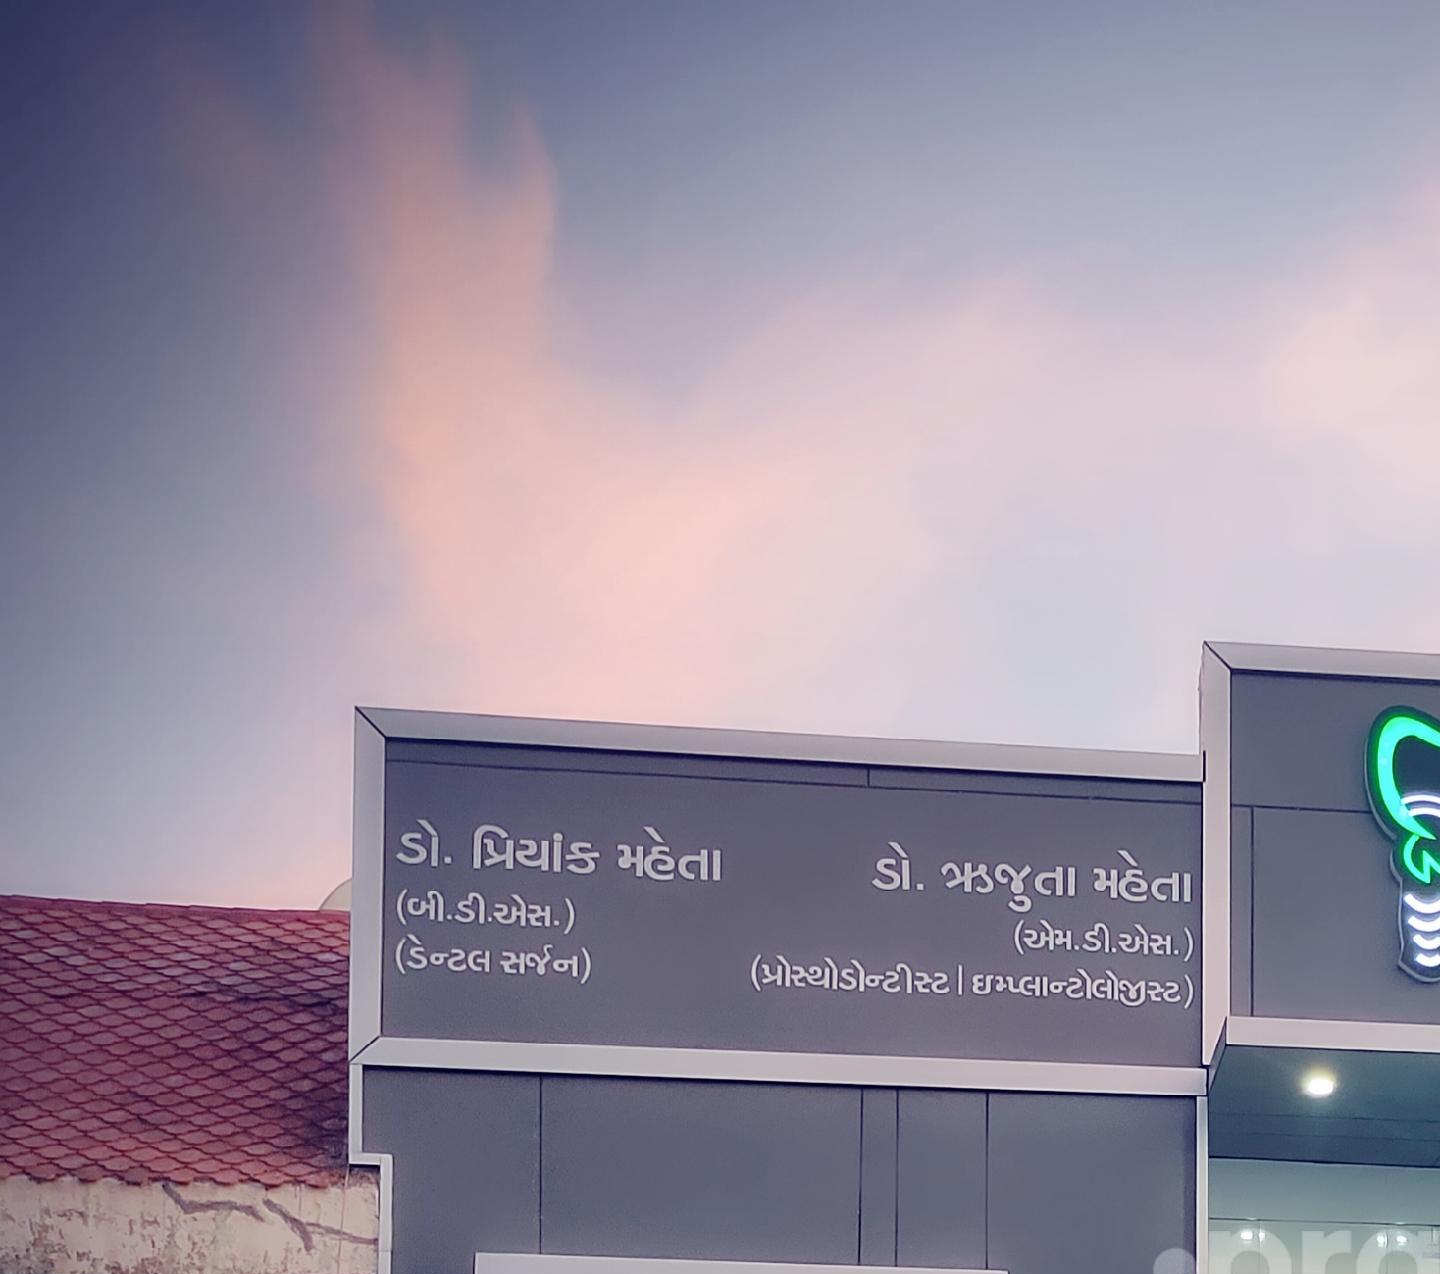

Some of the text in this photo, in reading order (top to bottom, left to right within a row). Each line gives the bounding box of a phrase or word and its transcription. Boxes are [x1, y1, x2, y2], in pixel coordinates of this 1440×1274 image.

[473, 825, 600, 874] પ્રિયાંક
[617, 826, 721, 881] મહેતા
[941, 860, 1076, 913] ઋજુતા
[1093, 850, 1191, 903] મહેતા
[396, 889, 575, 935] (બી.ડી.એસ.)
[395, 934, 592, 984] (ડેન્ટલ સર્જન)
[1014, 919, 1194, 962] (એમ.ડી.એસ.)
